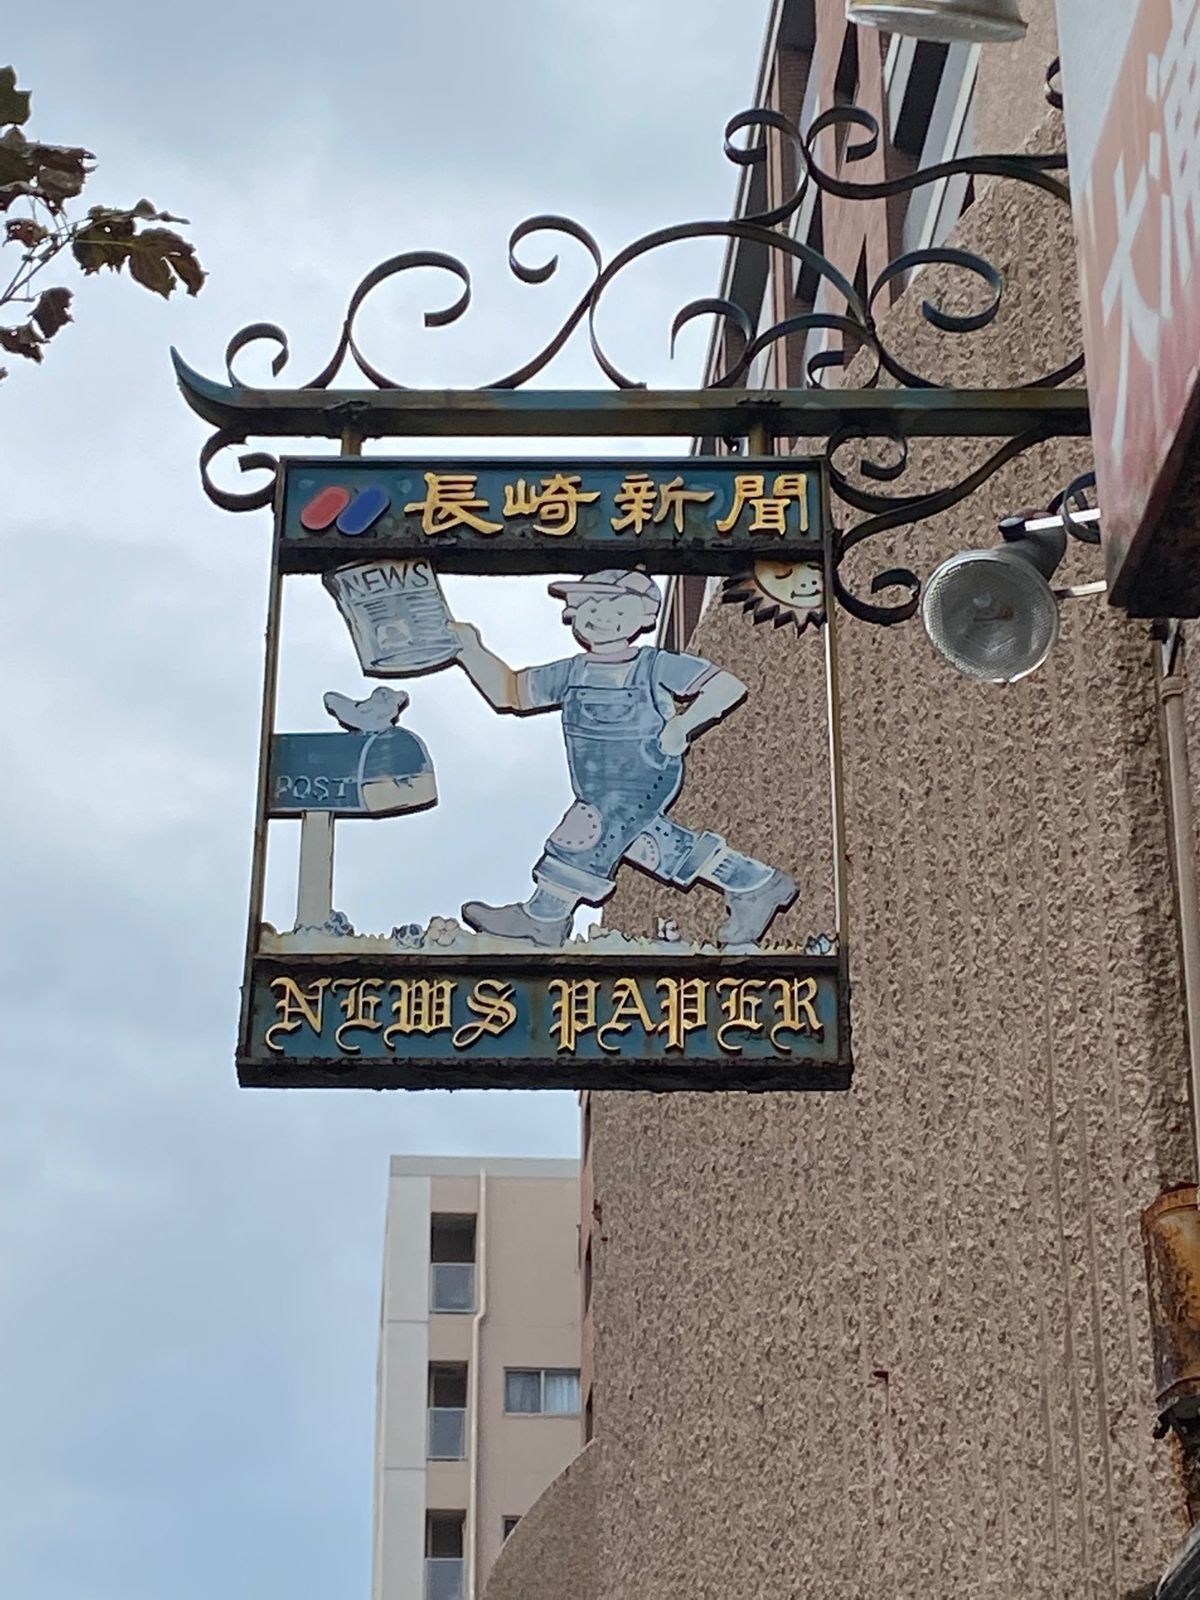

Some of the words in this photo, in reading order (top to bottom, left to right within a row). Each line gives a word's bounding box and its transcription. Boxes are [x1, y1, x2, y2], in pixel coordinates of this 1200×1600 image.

[404, 472, 809, 536] 長崎新聞
[341, 561, 429, 598] NEWS
[275, 775, 357, 800] POST
[265, 976, 518, 1052] NEWS
[548, 976, 823, 1052] PAPER
